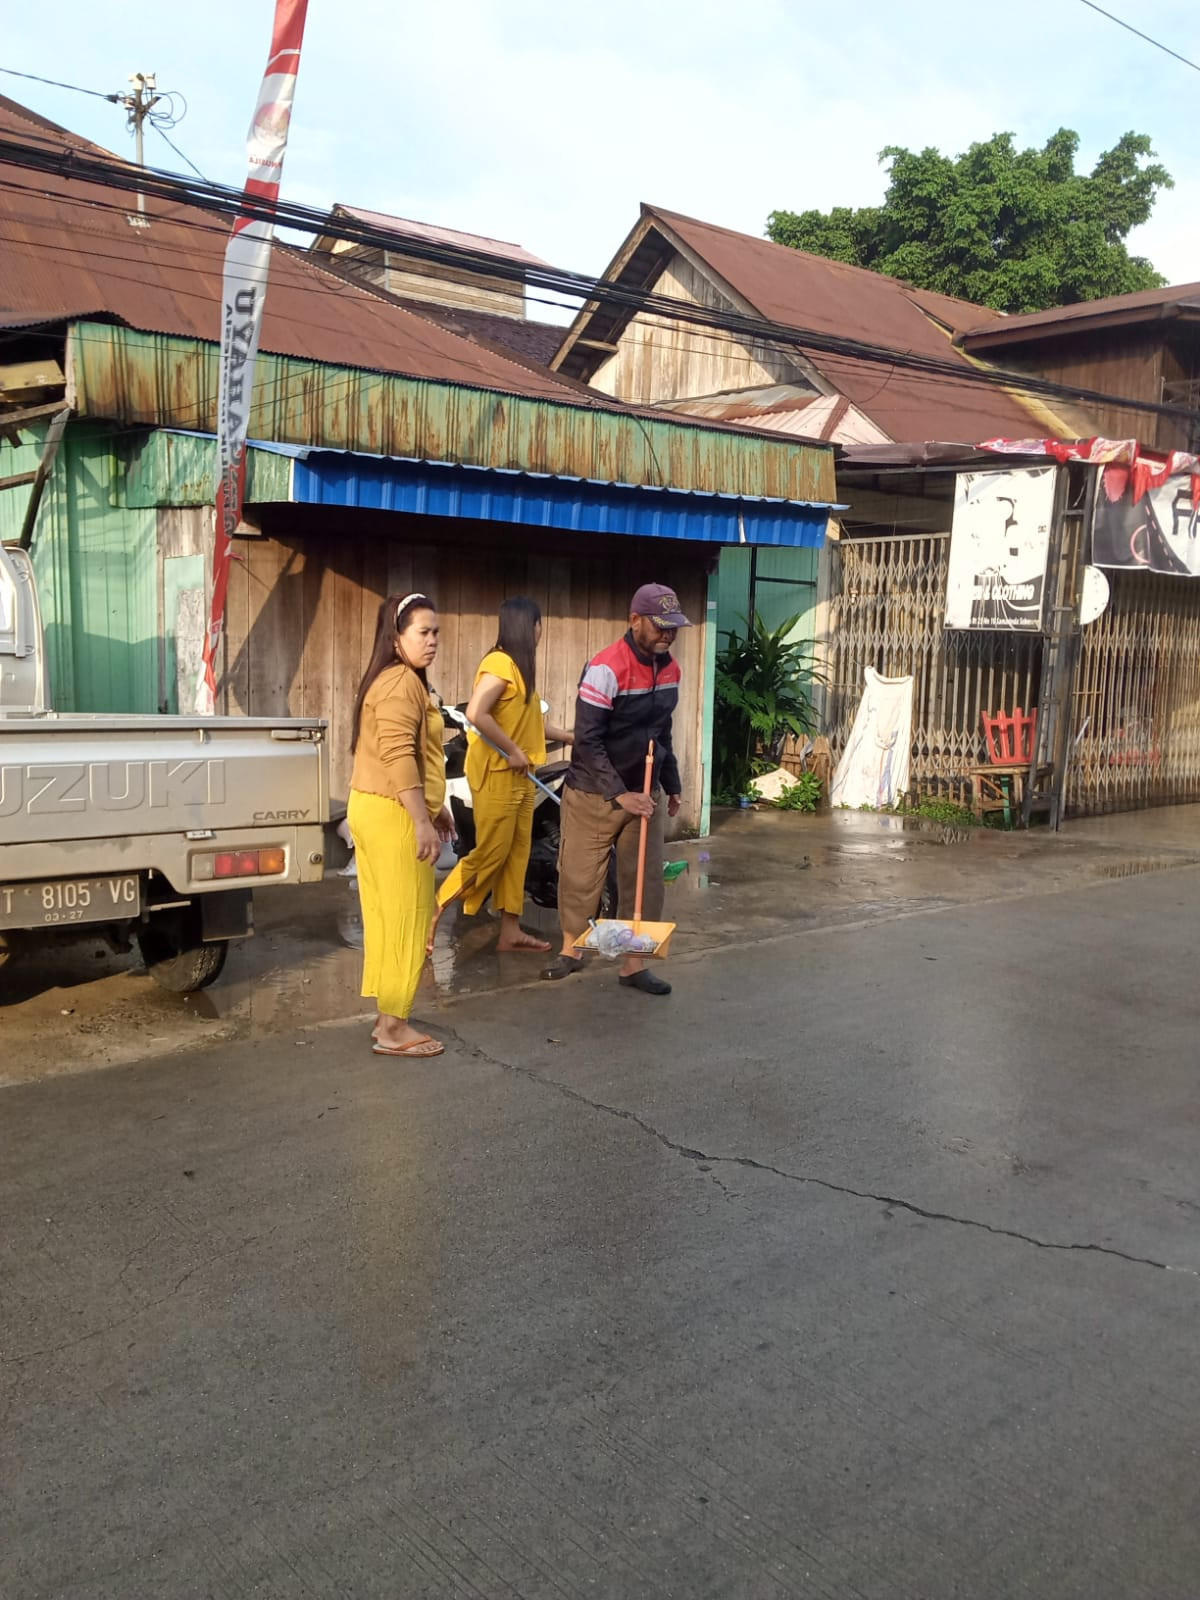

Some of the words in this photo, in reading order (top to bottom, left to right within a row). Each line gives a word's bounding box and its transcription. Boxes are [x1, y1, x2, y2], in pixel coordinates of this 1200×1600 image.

[252, 808, 311, 821] CARRY
[42, 882, 91, 909] 8105
[108, 879, 135, 904] VG
